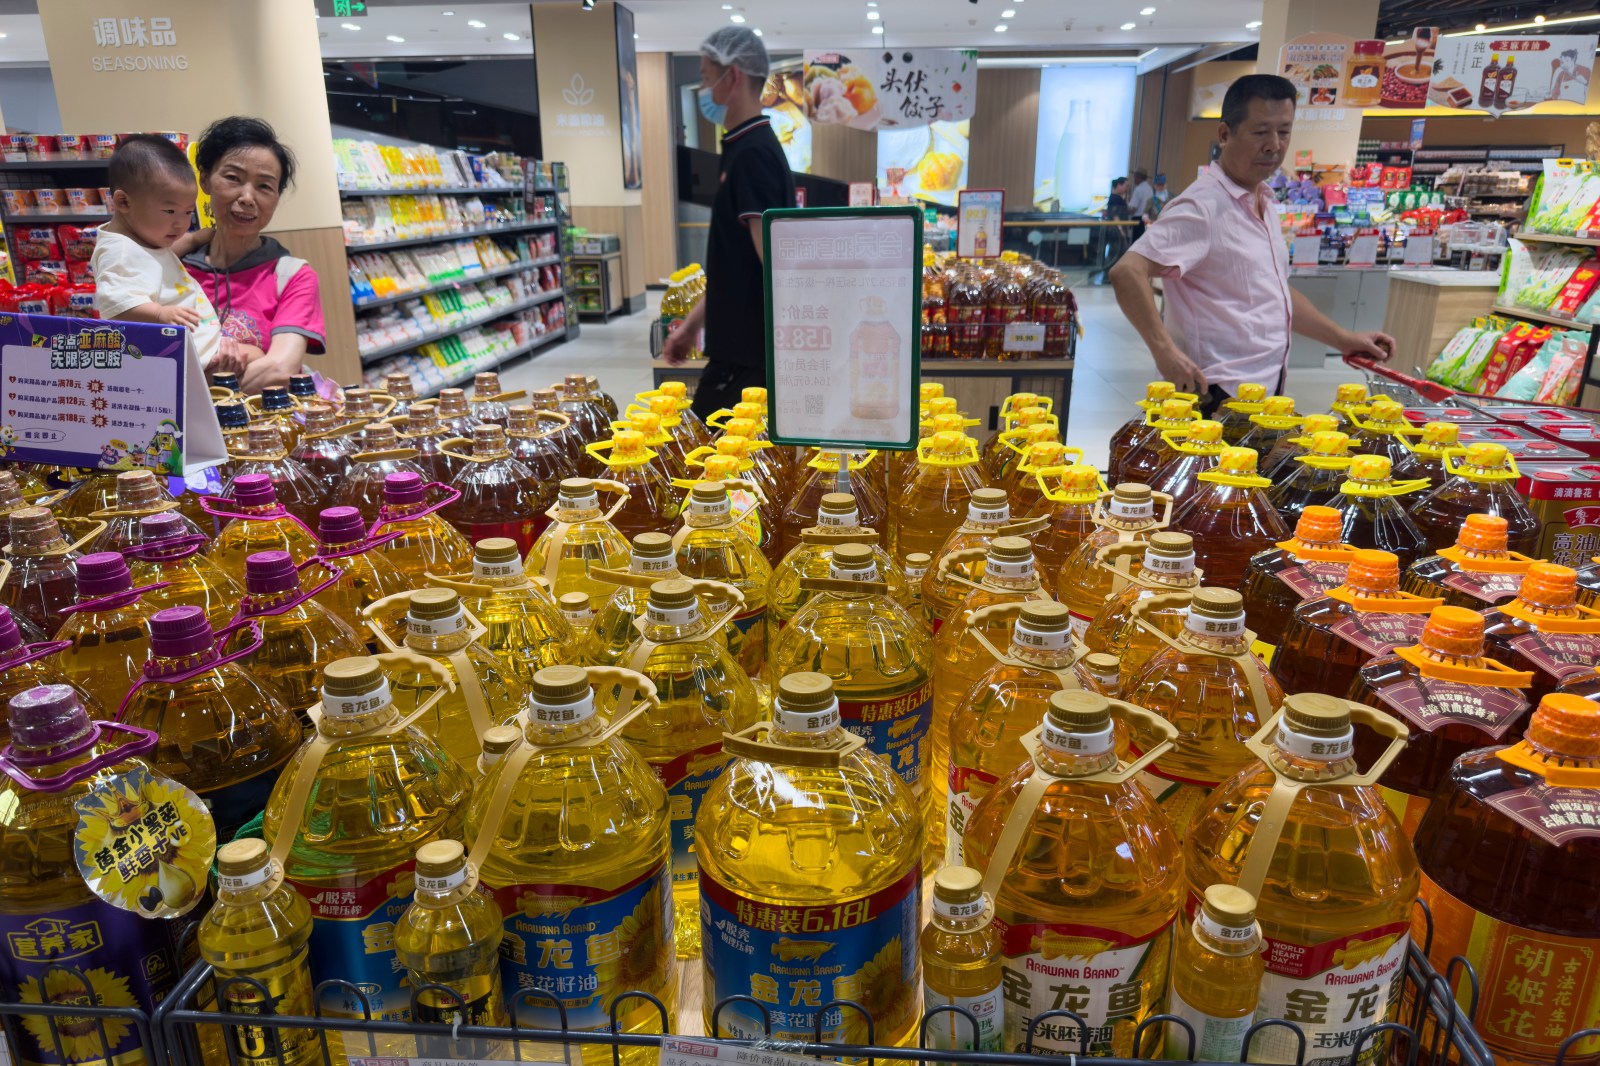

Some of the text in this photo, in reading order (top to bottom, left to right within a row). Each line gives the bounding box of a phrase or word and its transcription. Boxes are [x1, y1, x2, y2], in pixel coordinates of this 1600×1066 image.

[92, 17, 177, 48] 调味品
[1499, 40, 1542, 50] 芝麻香油
[1470, 40, 1486, 68] 纯正
[92, 55, 188, 72] SEASONING
[880, 68, 930, 94] 头伏
[900, 96, 945, 119] 饺子
[52, 332, 121, 350] 吃点亚麻酸
[51, 350, 122, 370] 无限多巴胺
[1554, 488, 1592, 498] 滴滴鲁花
[703, 504, 725, 513] 金龙鱼
[980, 511, 1004, 520] 金龙鱼
[1121, 506, 1146, 515] 金龙鱼
[481, 566, 512, 576] 金龙鱼
[642, 561, 670, 570] 金龙鱼
[1020, 562, 1034, 574] 金龙
[1151, 558, 1182, 570] 金龙鱼
[1310, 585, 1331, 595] 文化
[1482, 583, 1520, 594] 文化遗
[646, 612, 667, 622] 龙鱼
[1205, 621, 1238, 633] 金龙鱼
[1371, 621, 1406, 632] 非物质
[1015, 630, 1043, 646] 金龙鱼
[1554, 641, 1594, 654] 非物质
[341, 697, 381, 714] 金龙鱼
[1428, 694, 1482, 706] 中国发明专利
[536, 707, 575, 723] 金龙鱼
[807, 709, 839, 728] 金龙鱼
[1418, 702, 1498, 722] 去除黄曲霉毒素
[850, 726, 872, 736] 脱壳
[1045, 729, 1083, 750] 金龙鱼
[1310, 740, 1350, 756] 金龙鱼
[1549, 802, 1600, 812] 中国发明
[95, 800, 179, 870] 黄金小黑葵
[171, 825, 187, 841] VE
[418, 878, 448, 889] 金龙鱼
[326, 892, 356, 904] 脱壳
[318, 904, 362, 916] 物理压榨
[736, 898, 878, 934] 特惠装6.18L
[950, 904, 979, 916] 金龙鱼
[516, 920, 596, 935] ARAWANA BRAND
[726, 920, 750, 942] 脱壳
[1220, 927, 1252, 938] 金龙鱼
[15, 928, 96, 958] 营养家
[499, 929, 622, 970] 金龙鱼
[1272, 941, 1306, 954] WORLD
[1270, 955, 1288, 966] DAY
[1272, 948, 1300, 960] HEART
[770, 964, 842, 976] ARAWANA BRAND
[1026, 958, 1120, 979] ARAWANA BRAND
[1324, 958, 1399, 986] ARAWANA BRAND
[518, 972, 598, 993] 葵花籽油
[750, 972, 863, 1007] 金龙鱼
[1002, 965, 1143, 1020] 金龙鱼
[1498, 944, 1554, 1038] 胡姬花
[1544, 958, 1582, 1038] 古法花生油
